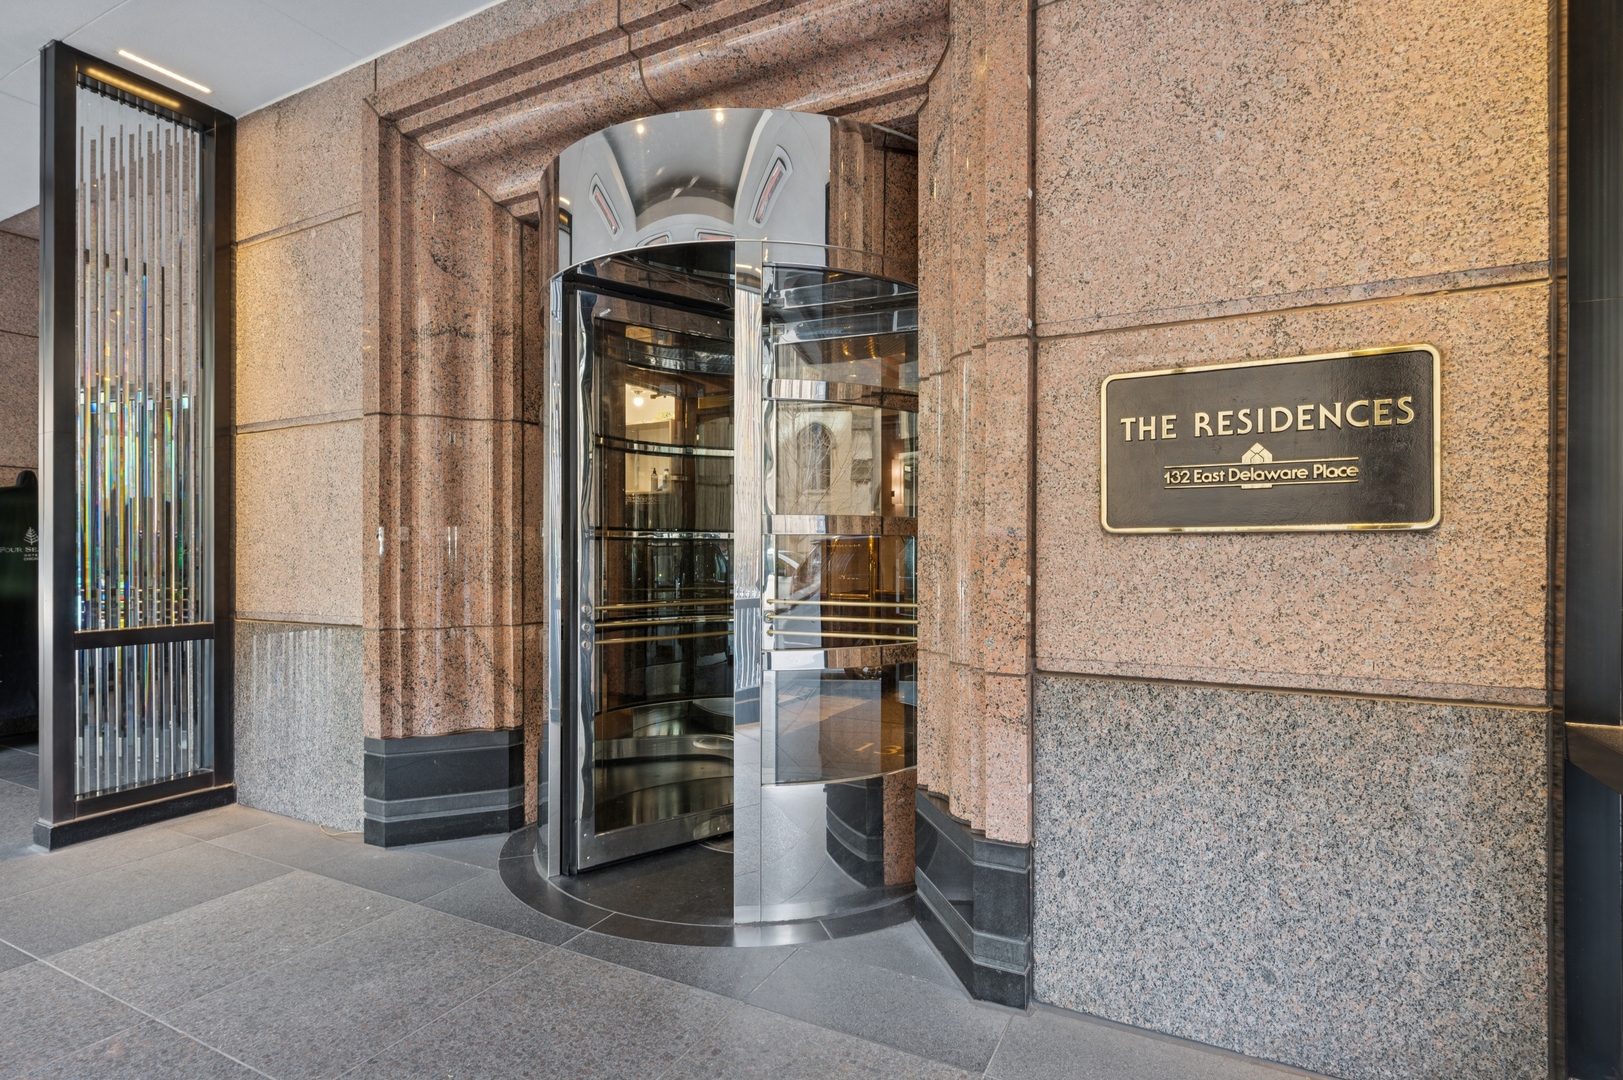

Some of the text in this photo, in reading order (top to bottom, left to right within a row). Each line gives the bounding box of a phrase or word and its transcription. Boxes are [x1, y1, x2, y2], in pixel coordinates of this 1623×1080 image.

[1120, 396, 1415, 442] THE RESIDENCES
[1163, 464, 1359, 484] 132 East Delaware Place
